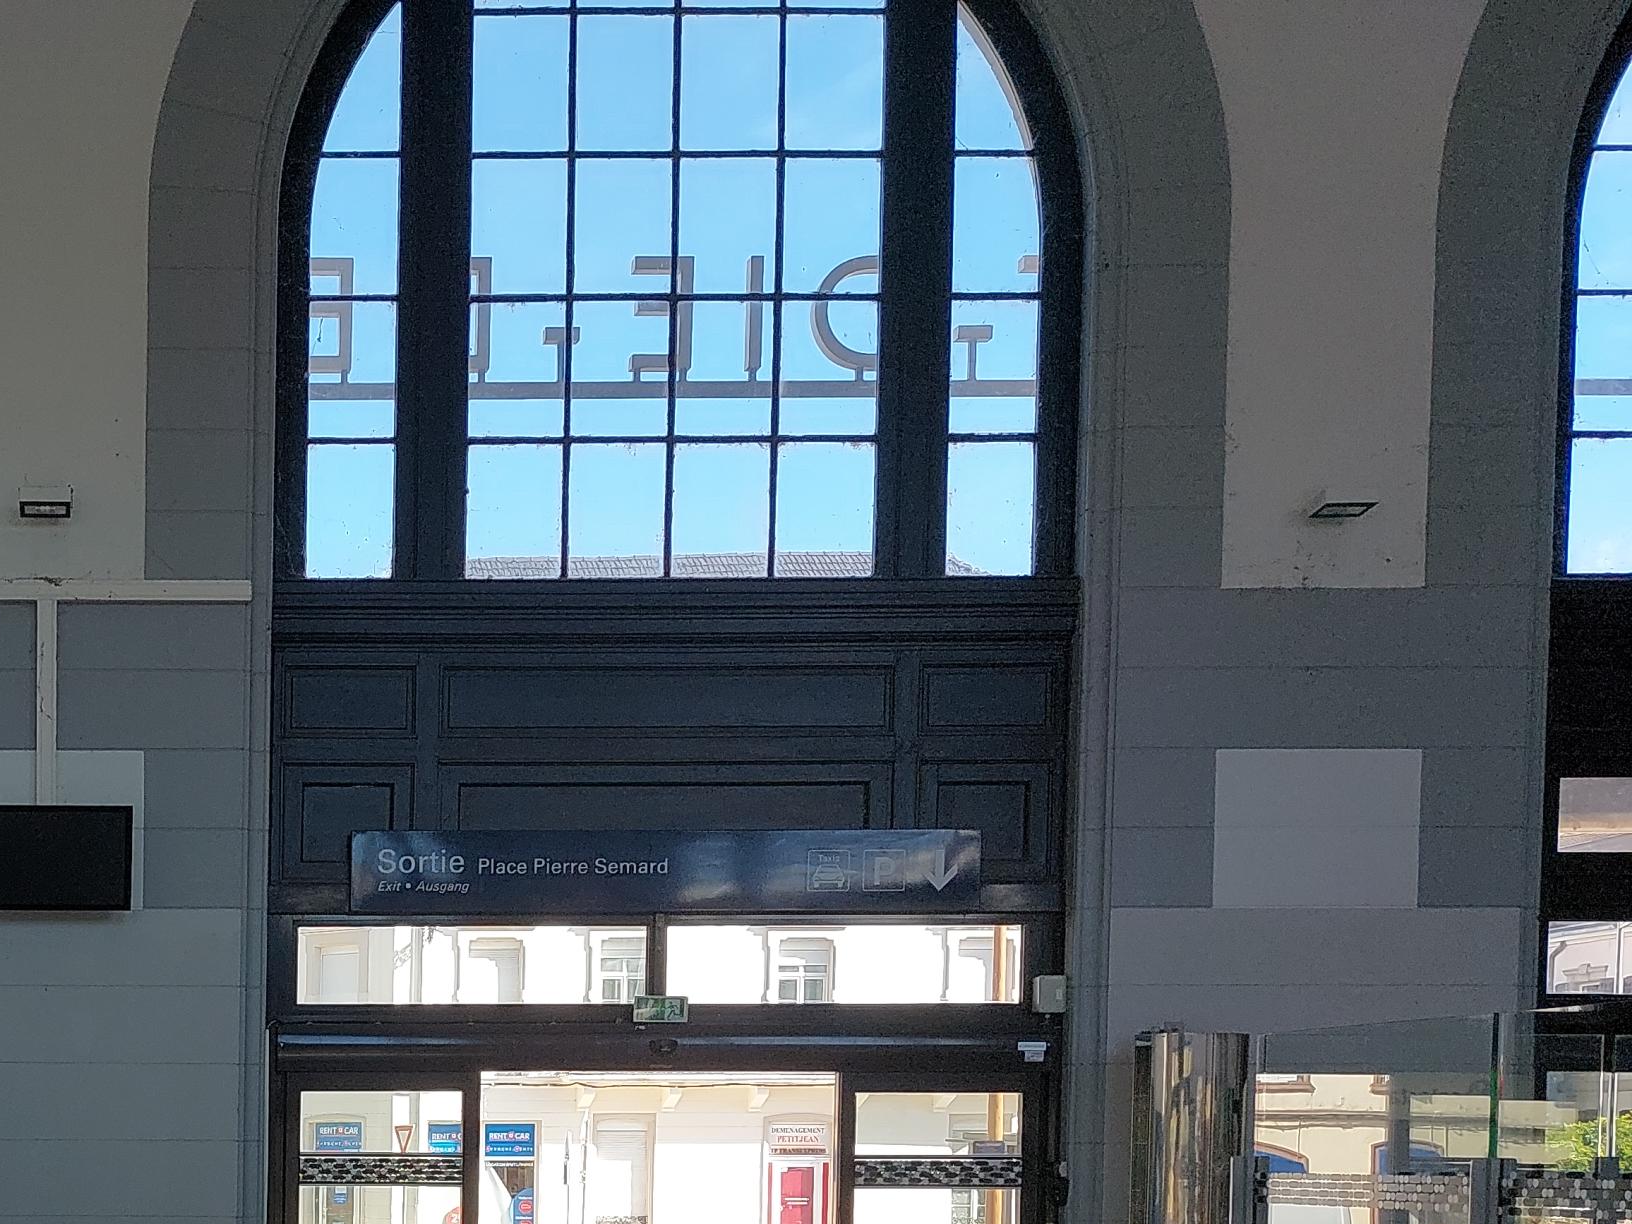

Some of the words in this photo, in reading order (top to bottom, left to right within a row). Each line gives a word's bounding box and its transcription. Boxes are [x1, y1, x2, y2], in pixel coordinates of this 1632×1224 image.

[377, 848, 465, 874] Sortie
[478, 858, 528, 875] Place
[533, 858, 589, 875] Pierre
[594, 858, 669, 875] Semard
[378, 881, 402, 892] Exit
[415, 881, 470, 894] Ausgang
[319, 1126, 337, 1135] RENT
[344, 1126, 359, 1135] CAR
[431, 1132, 451, 1141] RENT
[488, 1132, 507, 1141] RENT
[514, 1132, 530, 1141] CAR
